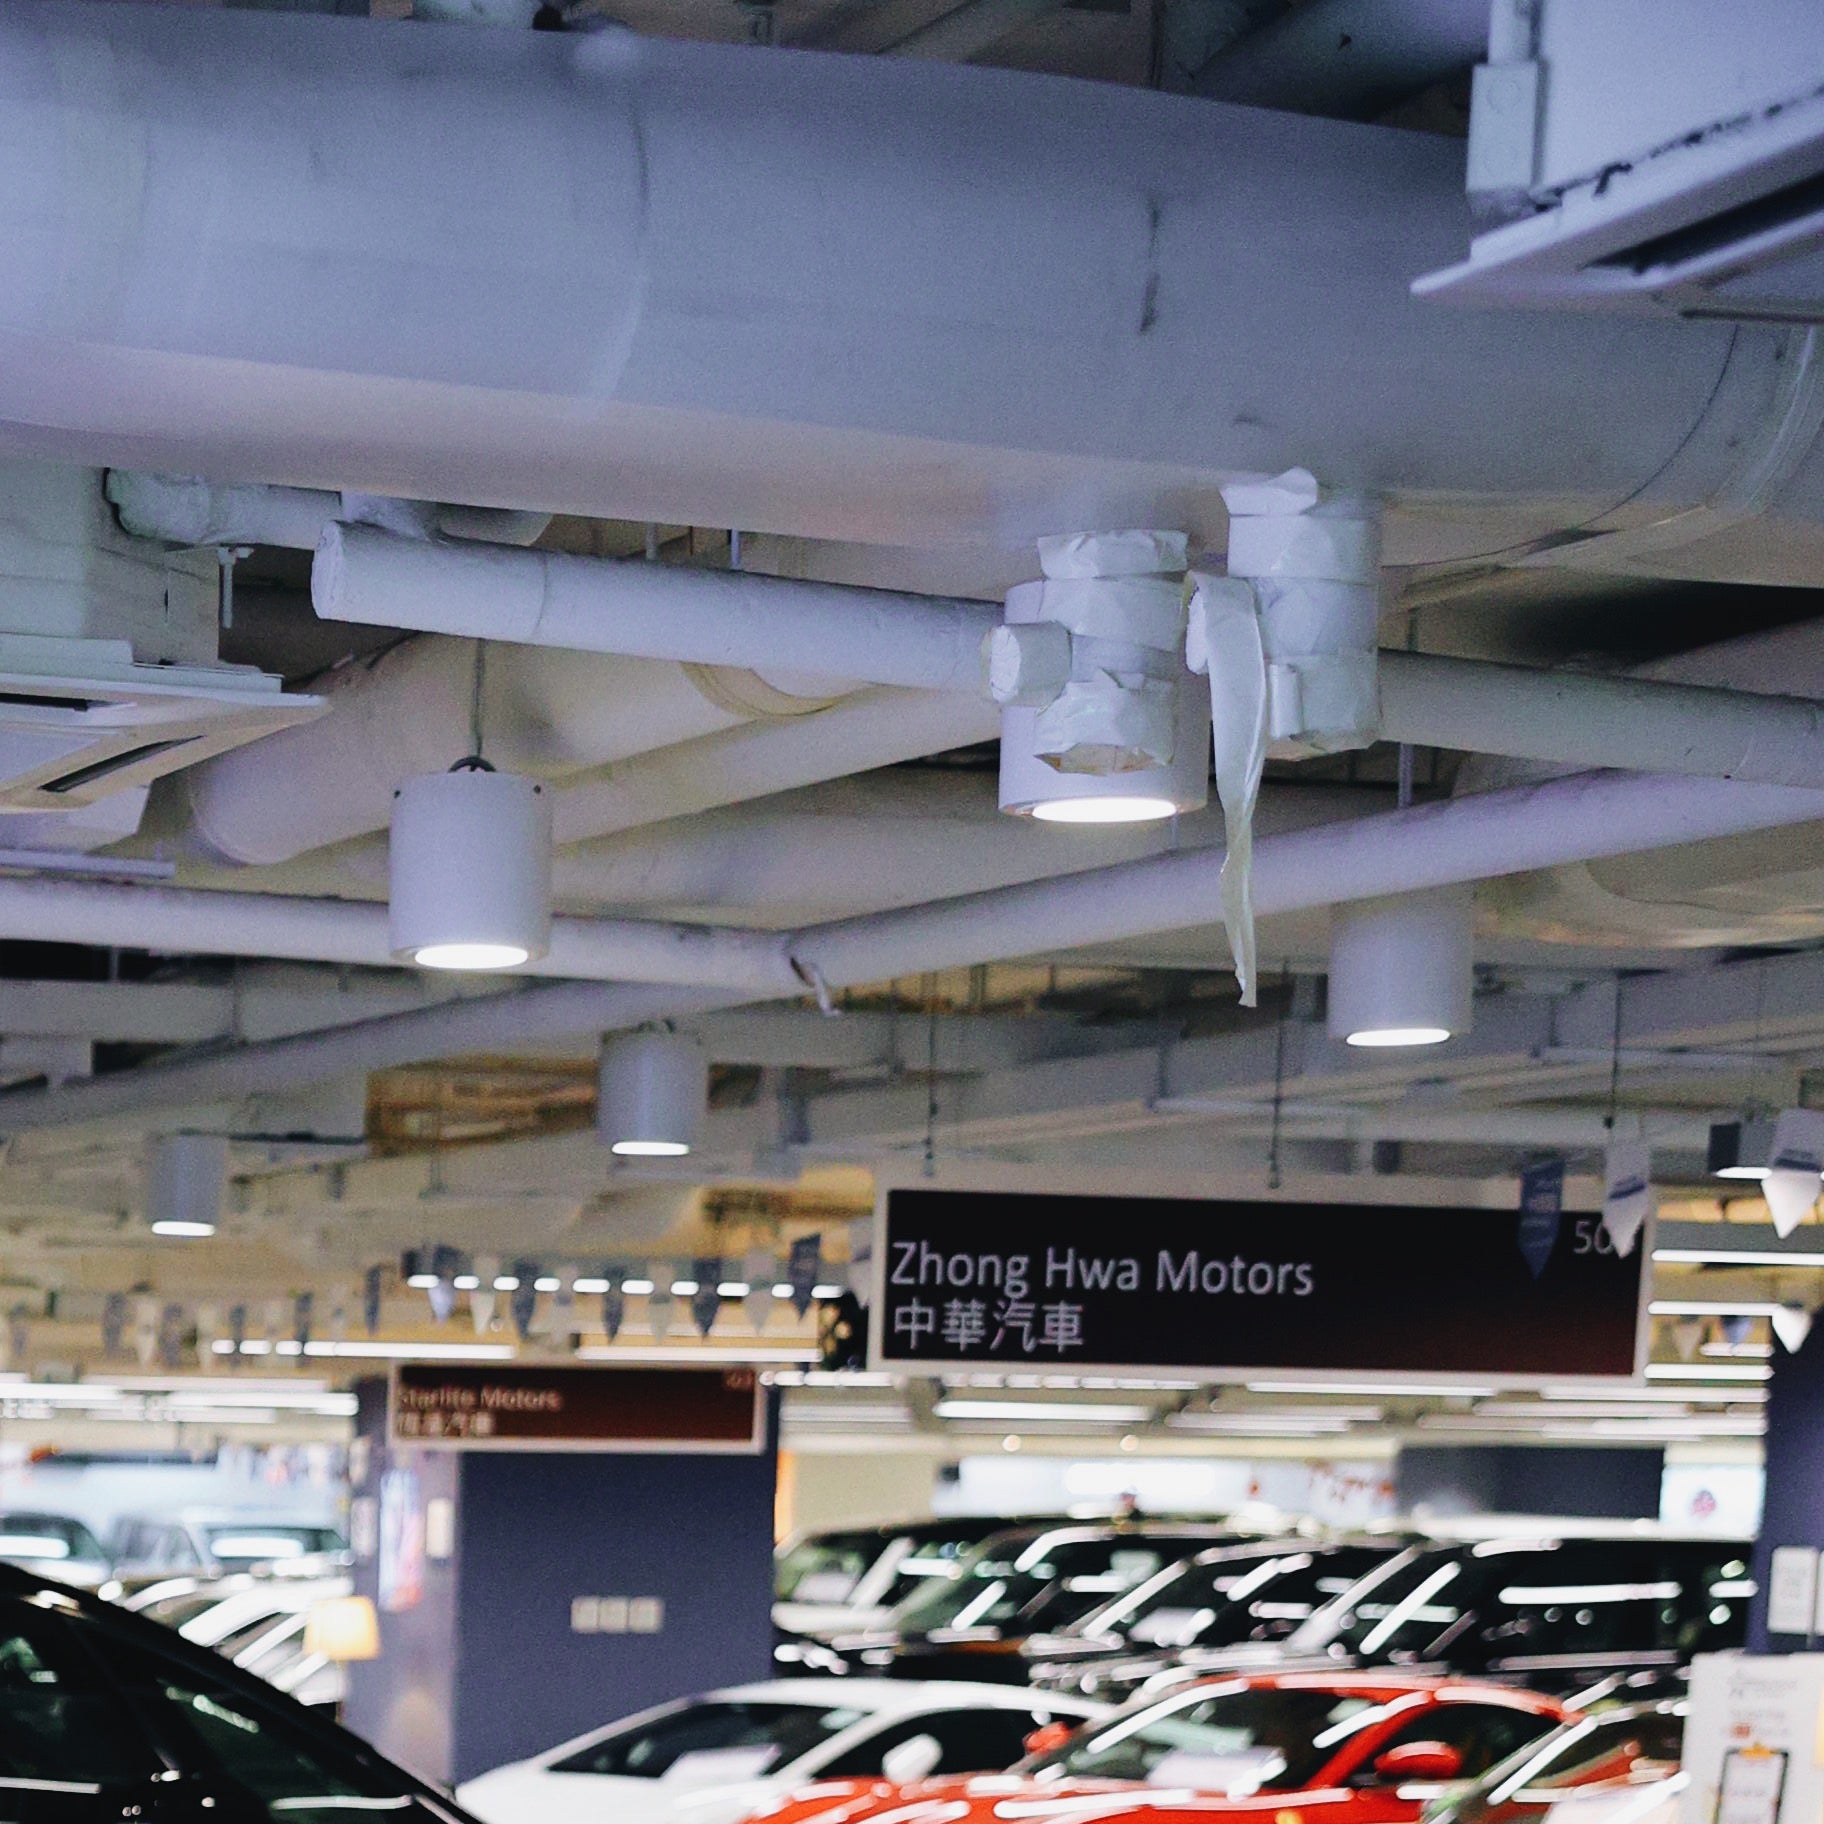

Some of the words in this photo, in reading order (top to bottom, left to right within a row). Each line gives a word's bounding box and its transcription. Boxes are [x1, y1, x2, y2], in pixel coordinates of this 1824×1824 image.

[890, 1240, 1031, 1300] Zhong
[1044, 1246, 1140, 1291] Hwa
[1155, 1249, 1315, 1296] Motors
[893, 1297, 1084, 1353] 中華汽車
